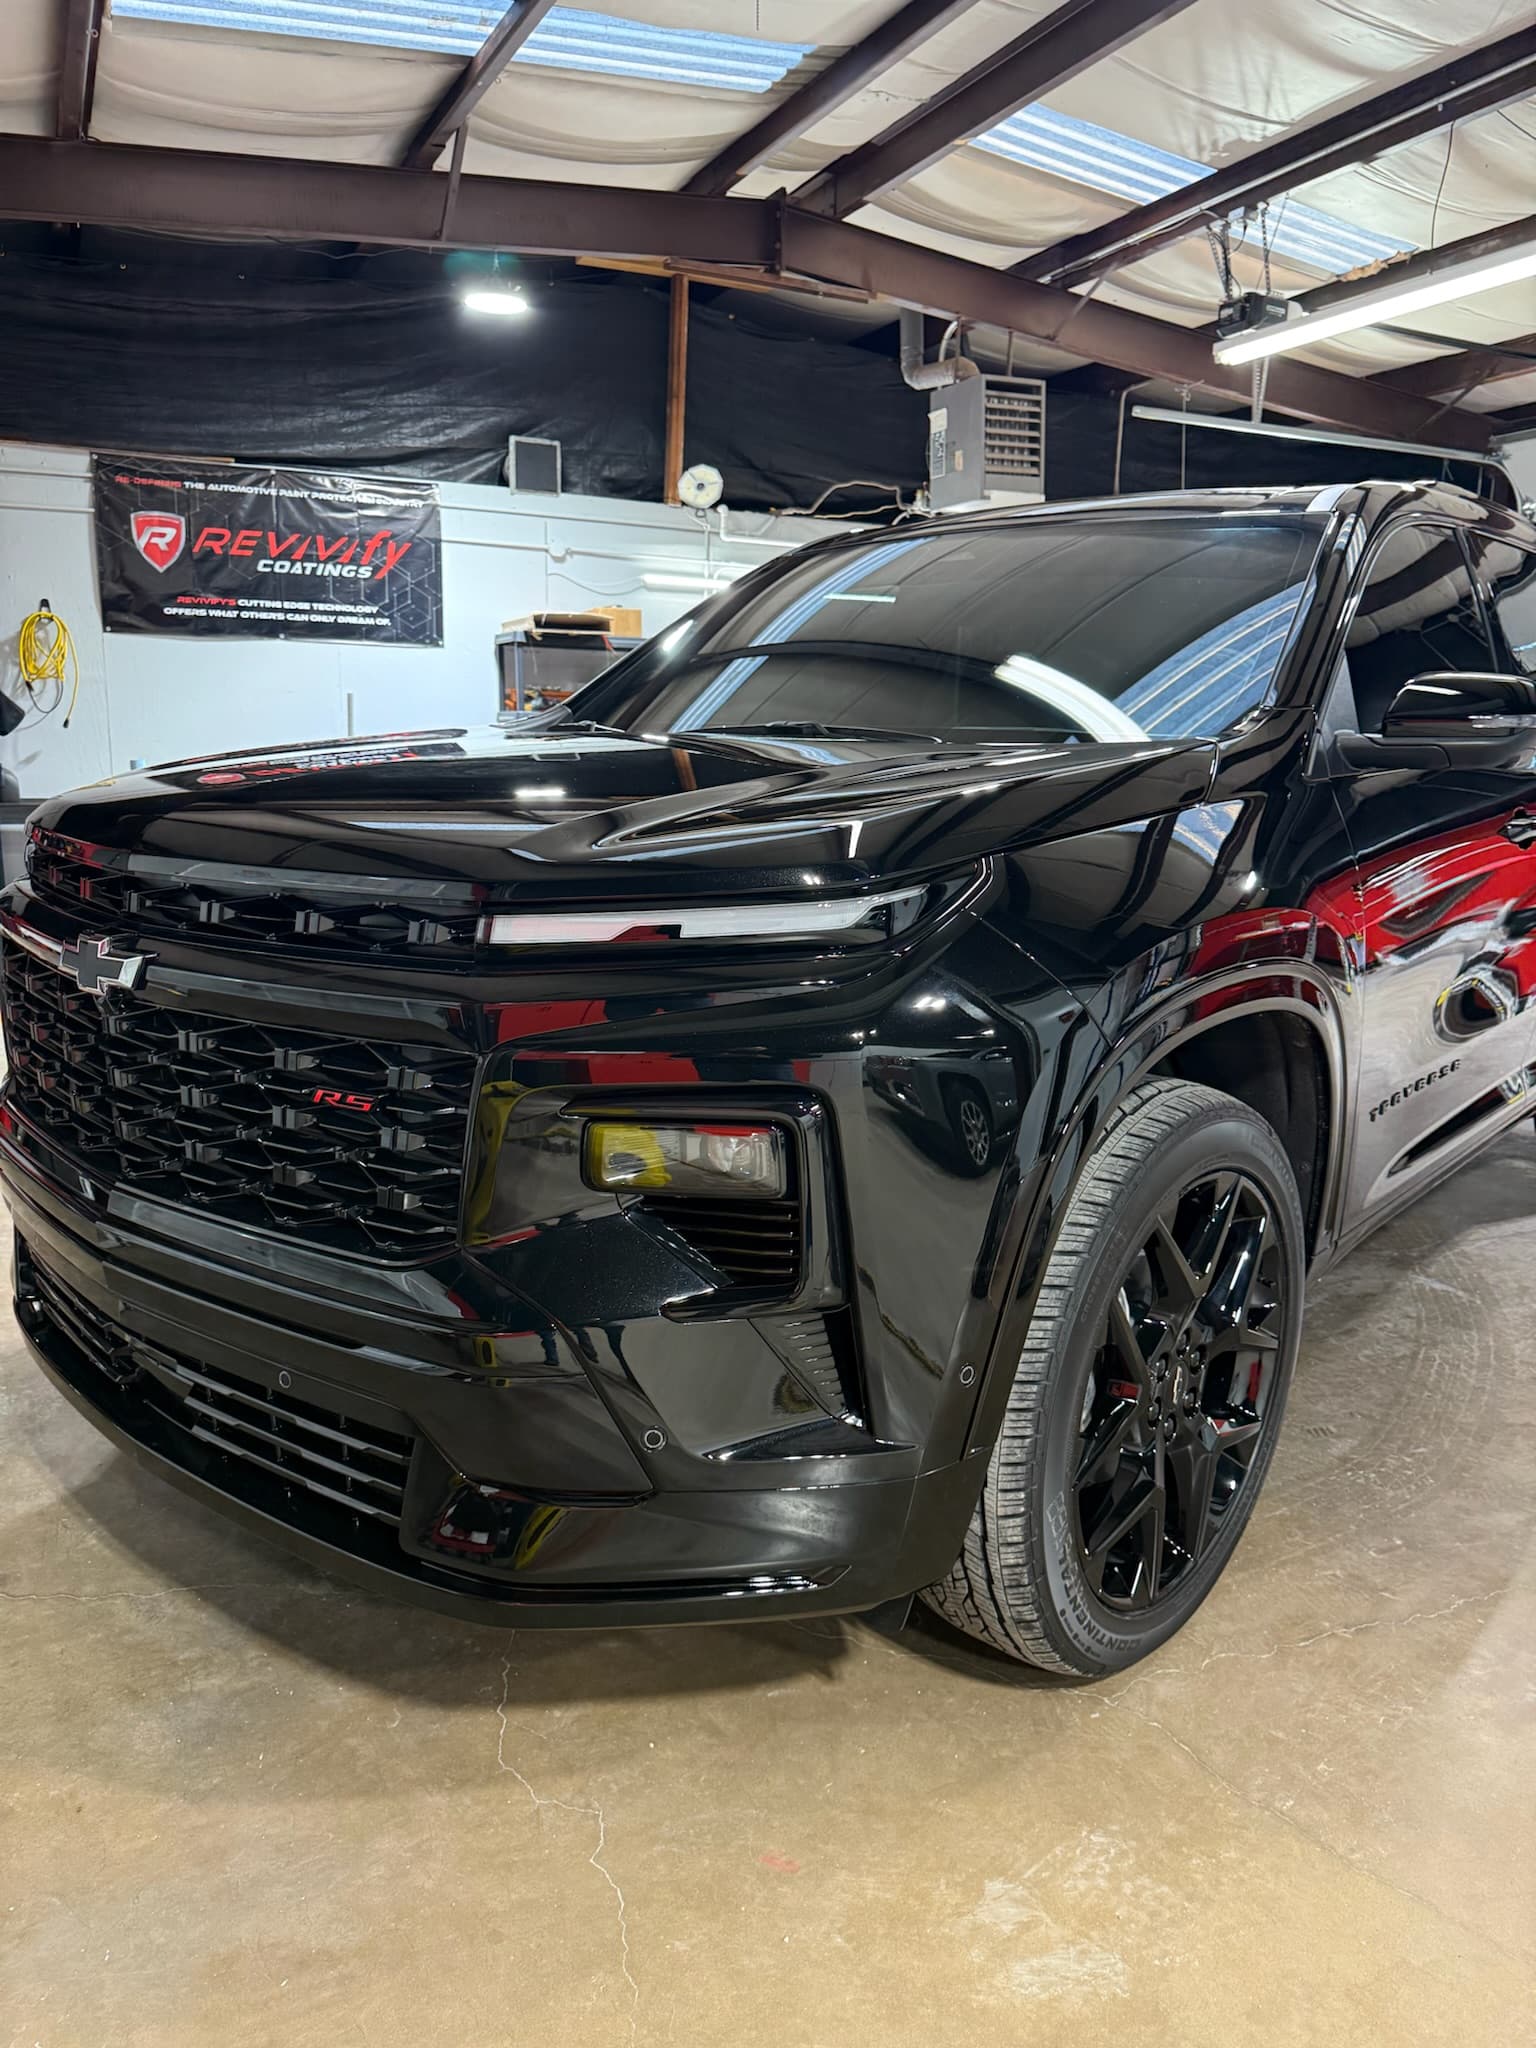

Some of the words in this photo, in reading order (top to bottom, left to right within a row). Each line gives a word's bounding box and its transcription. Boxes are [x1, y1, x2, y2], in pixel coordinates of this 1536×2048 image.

[183, 480, 205, 490] THE
[207, 482, 278, 496] AUTOMOTIVE
[279, 488, 310, 499] PAINT
[256, 559, 373, 579] COATINGS
[163, 606, 207, 617] OFFERS
[208, 608, 239, 618] WHAT
[286, 612, 309, 622] CAN
[310, 613, 336, 623] ONLY
[337, 615, 375, 625] DREAM
[237, 598, 282, 609] CUTTING
[283, 600, 311, 610] EDGE
[312, 602, 379, 614] TECHNOLOGY
[313, 1089, 374, 1112] RS
